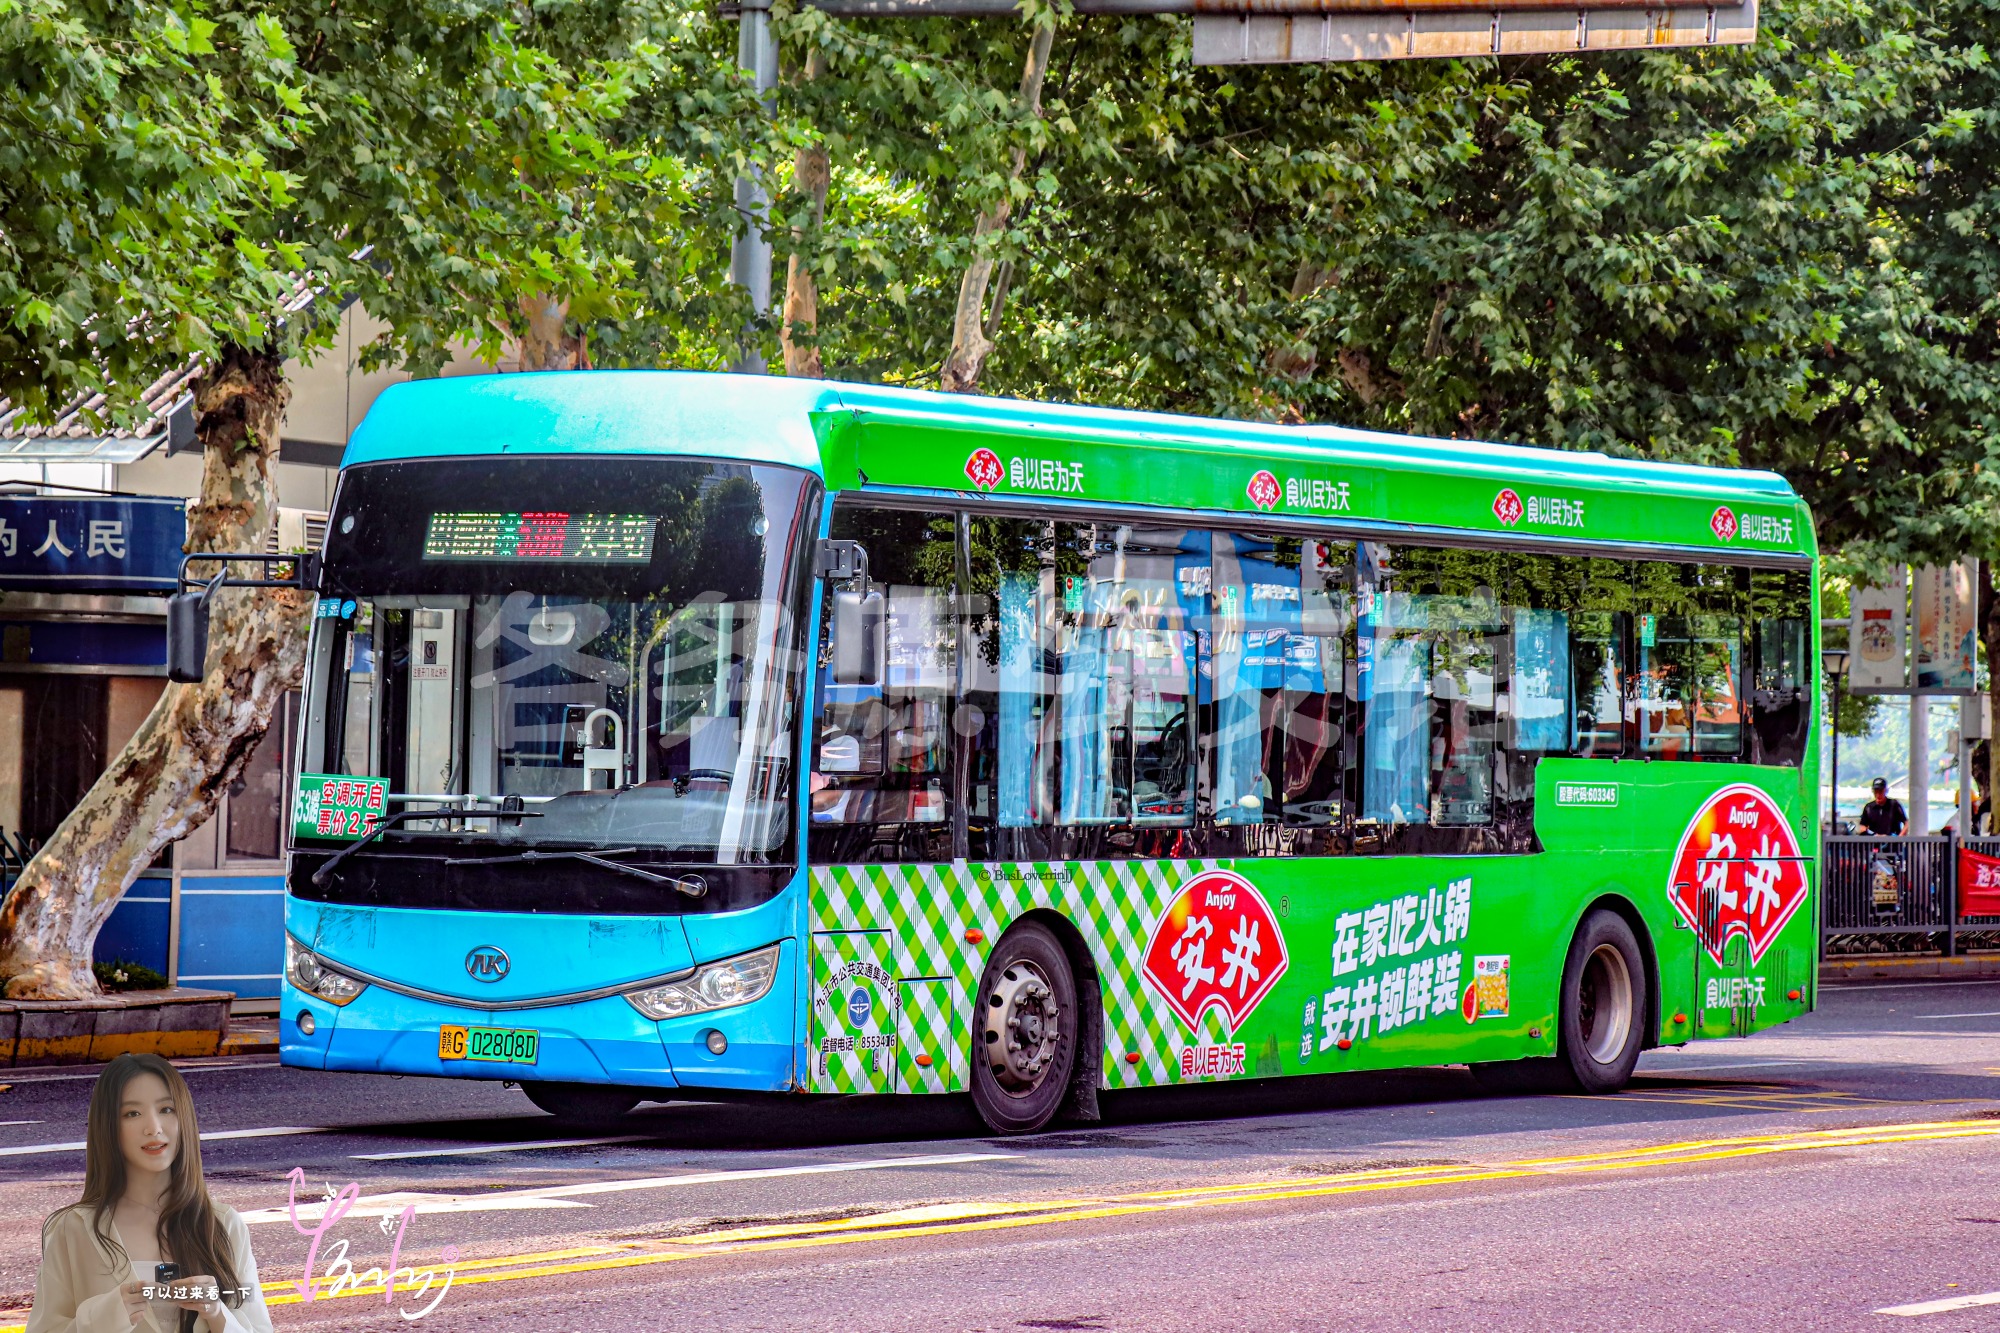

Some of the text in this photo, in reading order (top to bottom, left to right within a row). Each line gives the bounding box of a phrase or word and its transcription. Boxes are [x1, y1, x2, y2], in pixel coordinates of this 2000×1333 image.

[1009, 456, 1084, 493] 食以民为天
[1285, 477, 1351, 512] 食以民为天
[1527, 495, 1585, 528] 食以民为天
[1740, 513, 1793, 544] 食以民为天
[321, 780, 384, 810] 空调开启
[317, 809, 379, 837] 票价2元
[1729, 800, 1759, 828] Anjoy
[1697, 831, 1782, 927] 安井
[1205, 883, 1237, 910] Anjoy
[1331, 877, 1472, 977] 在家吃火锅
[1170, 914, 1261, 1002] 安井
[815, 961, 903, 1013] 九江市公共交通集团公司
[1319, 951, 1462, 1052] 安井锁鲜装
[1705, 977, 1766, 1009] 食以民为天
[1301, 1001, 1316, 1058] 就选
[1181, 1043, 1246, 1077] 食以民为天
